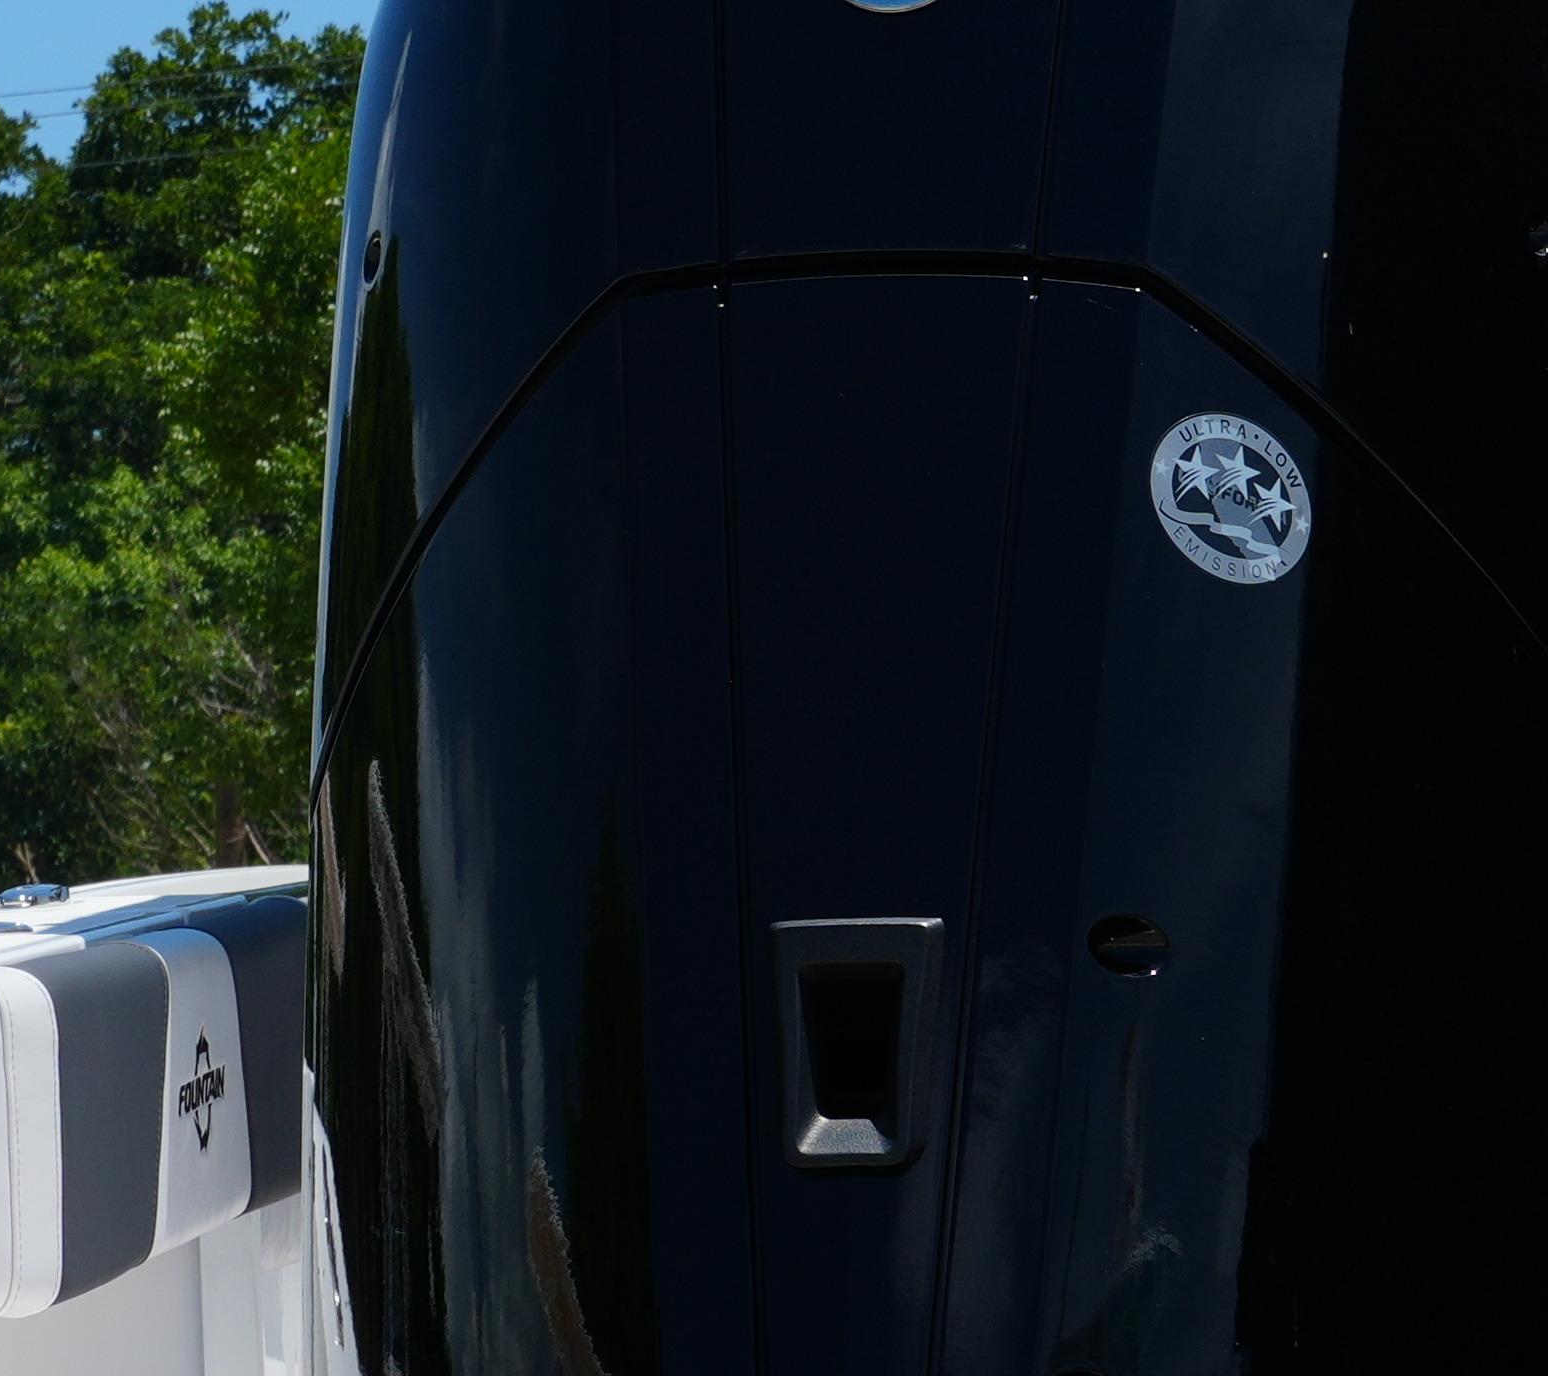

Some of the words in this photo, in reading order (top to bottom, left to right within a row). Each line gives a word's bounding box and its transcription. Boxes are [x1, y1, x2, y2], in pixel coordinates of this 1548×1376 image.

[1178, 419, 1247, 443] ULTRA
[1264, 440, 1302, 489] LOW
[1173, 526, 1278, 579] EMISSION
[178, 1064, 225, 1118] FOUNTAIN
